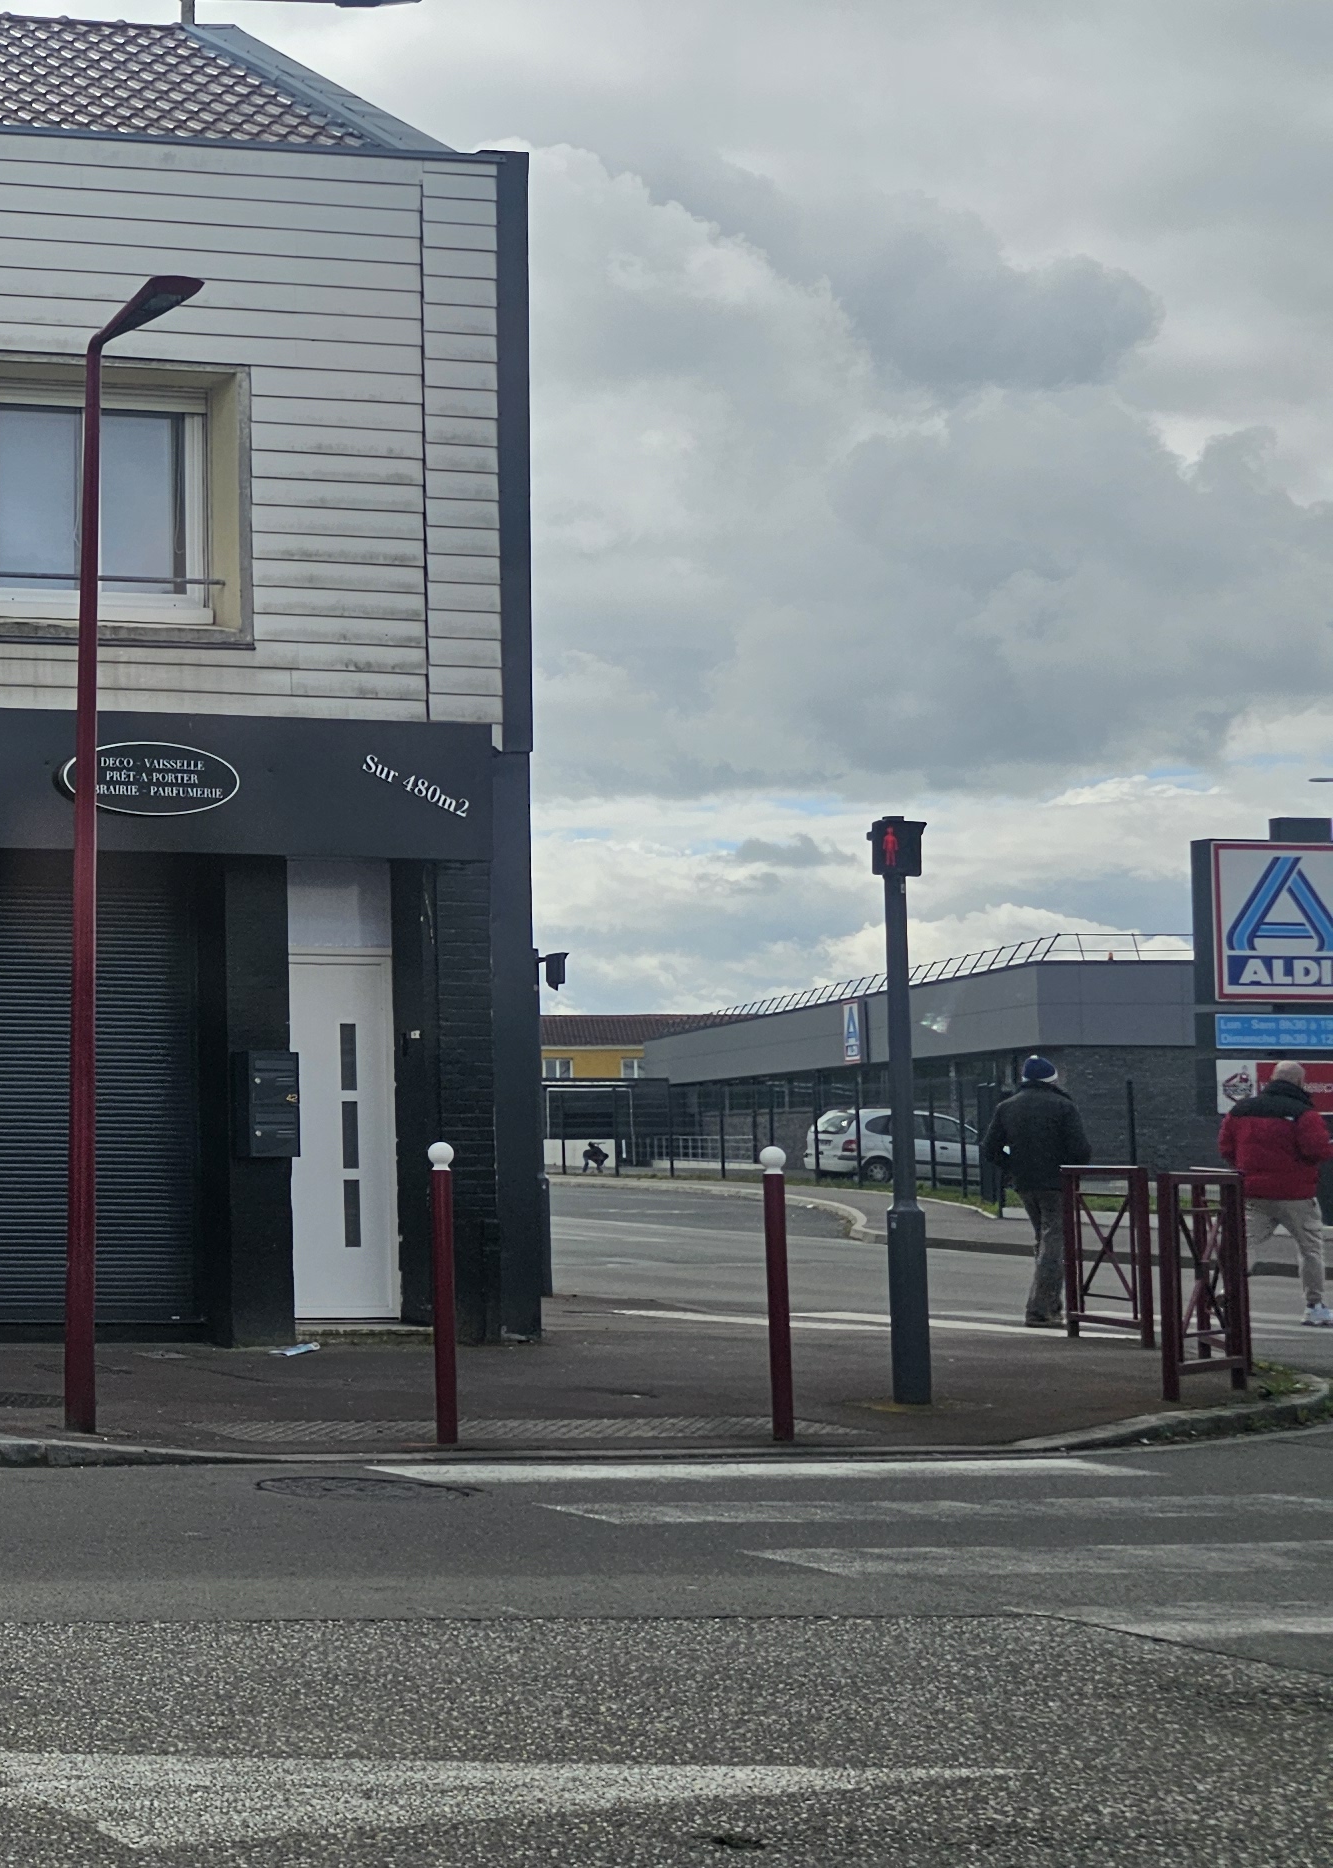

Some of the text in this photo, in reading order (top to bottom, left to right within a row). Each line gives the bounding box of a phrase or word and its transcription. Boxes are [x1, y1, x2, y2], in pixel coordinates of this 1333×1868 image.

[100, 757, 134, 768] DECO
[144, 758, 205, 771] VAISSELLE
[106, 769, 199, 784] PRÊT-A-PORTER
[95, 785, 139, 796] BRAIRIE
[150, 787, 223, 799] PARFUMERIE
[362, 754, 470, 818] Sur 480m2
[1238, 958, 1333, 985] ALDI
[285, 1093, 299, 1103] 42
